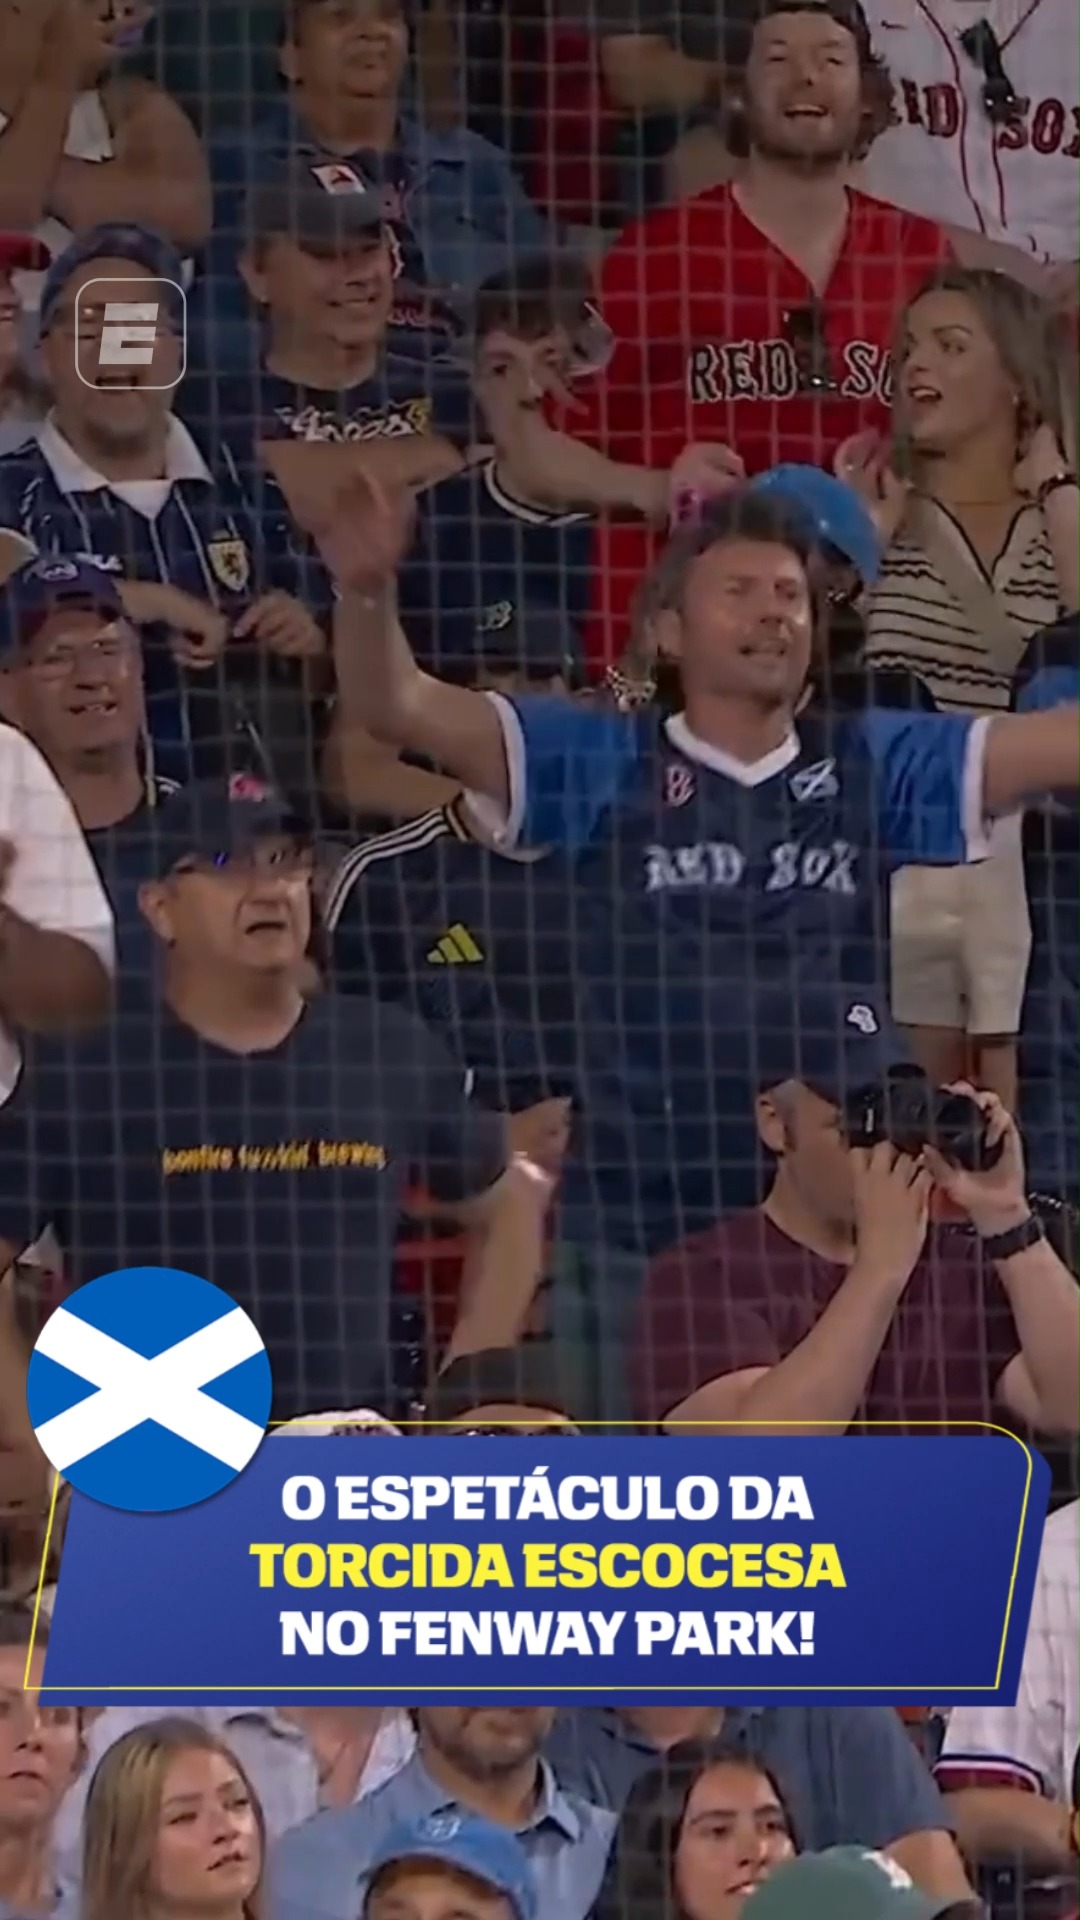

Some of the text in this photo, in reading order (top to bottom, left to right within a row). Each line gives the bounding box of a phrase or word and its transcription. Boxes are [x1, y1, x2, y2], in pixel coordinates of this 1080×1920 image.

[687, 338, 799, 404] RED
[643, 838, 859, 896] RED SOX
